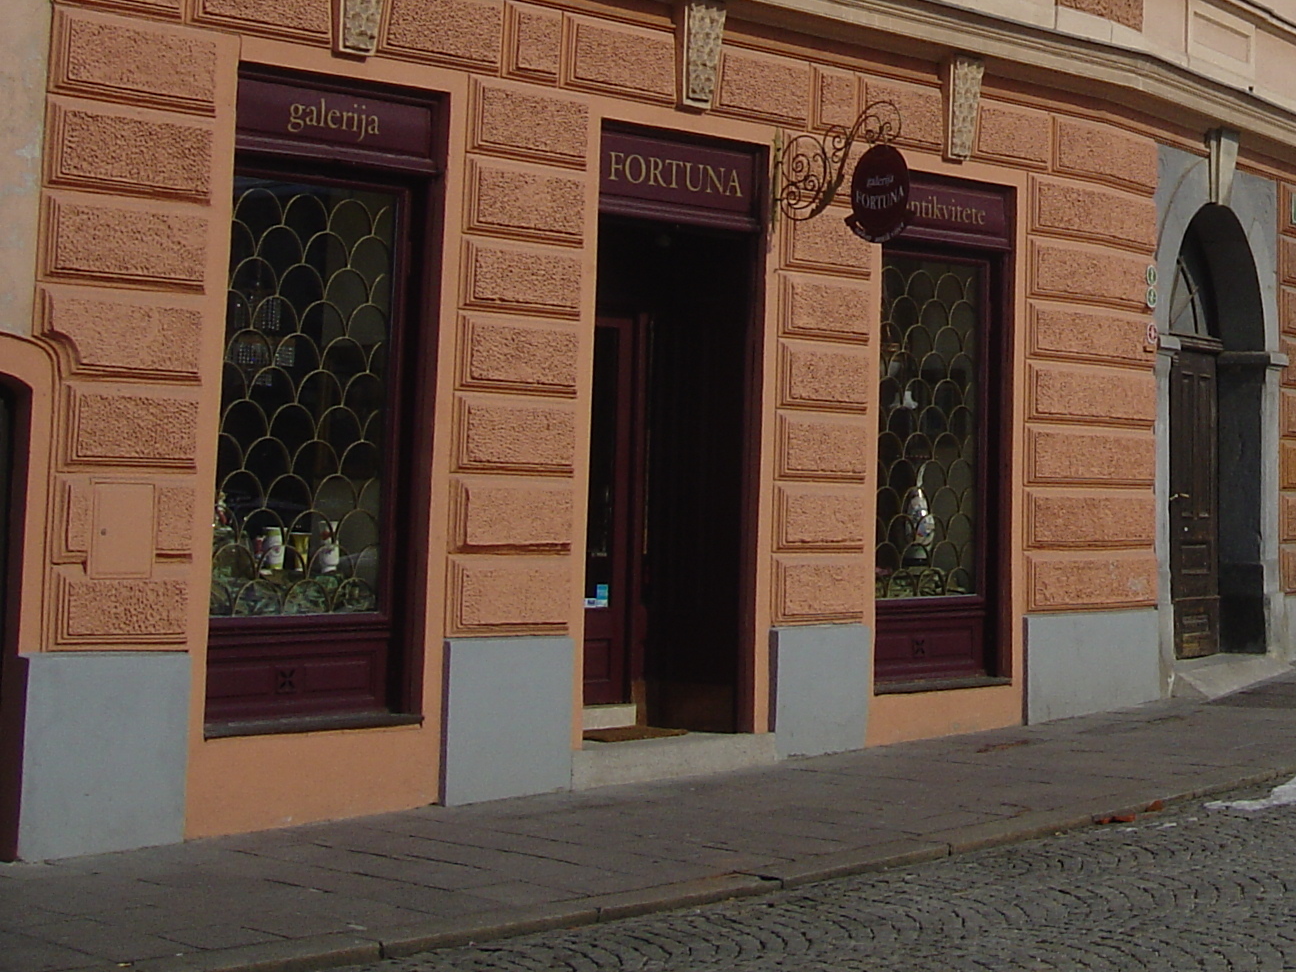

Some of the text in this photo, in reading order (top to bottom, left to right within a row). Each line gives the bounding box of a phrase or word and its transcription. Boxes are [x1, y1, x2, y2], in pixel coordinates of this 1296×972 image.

[287, 97, 381, 143] galerija
[608, 150, 744, 199] FORTUNA
[855, 185, 905, 210] FORTUNA
